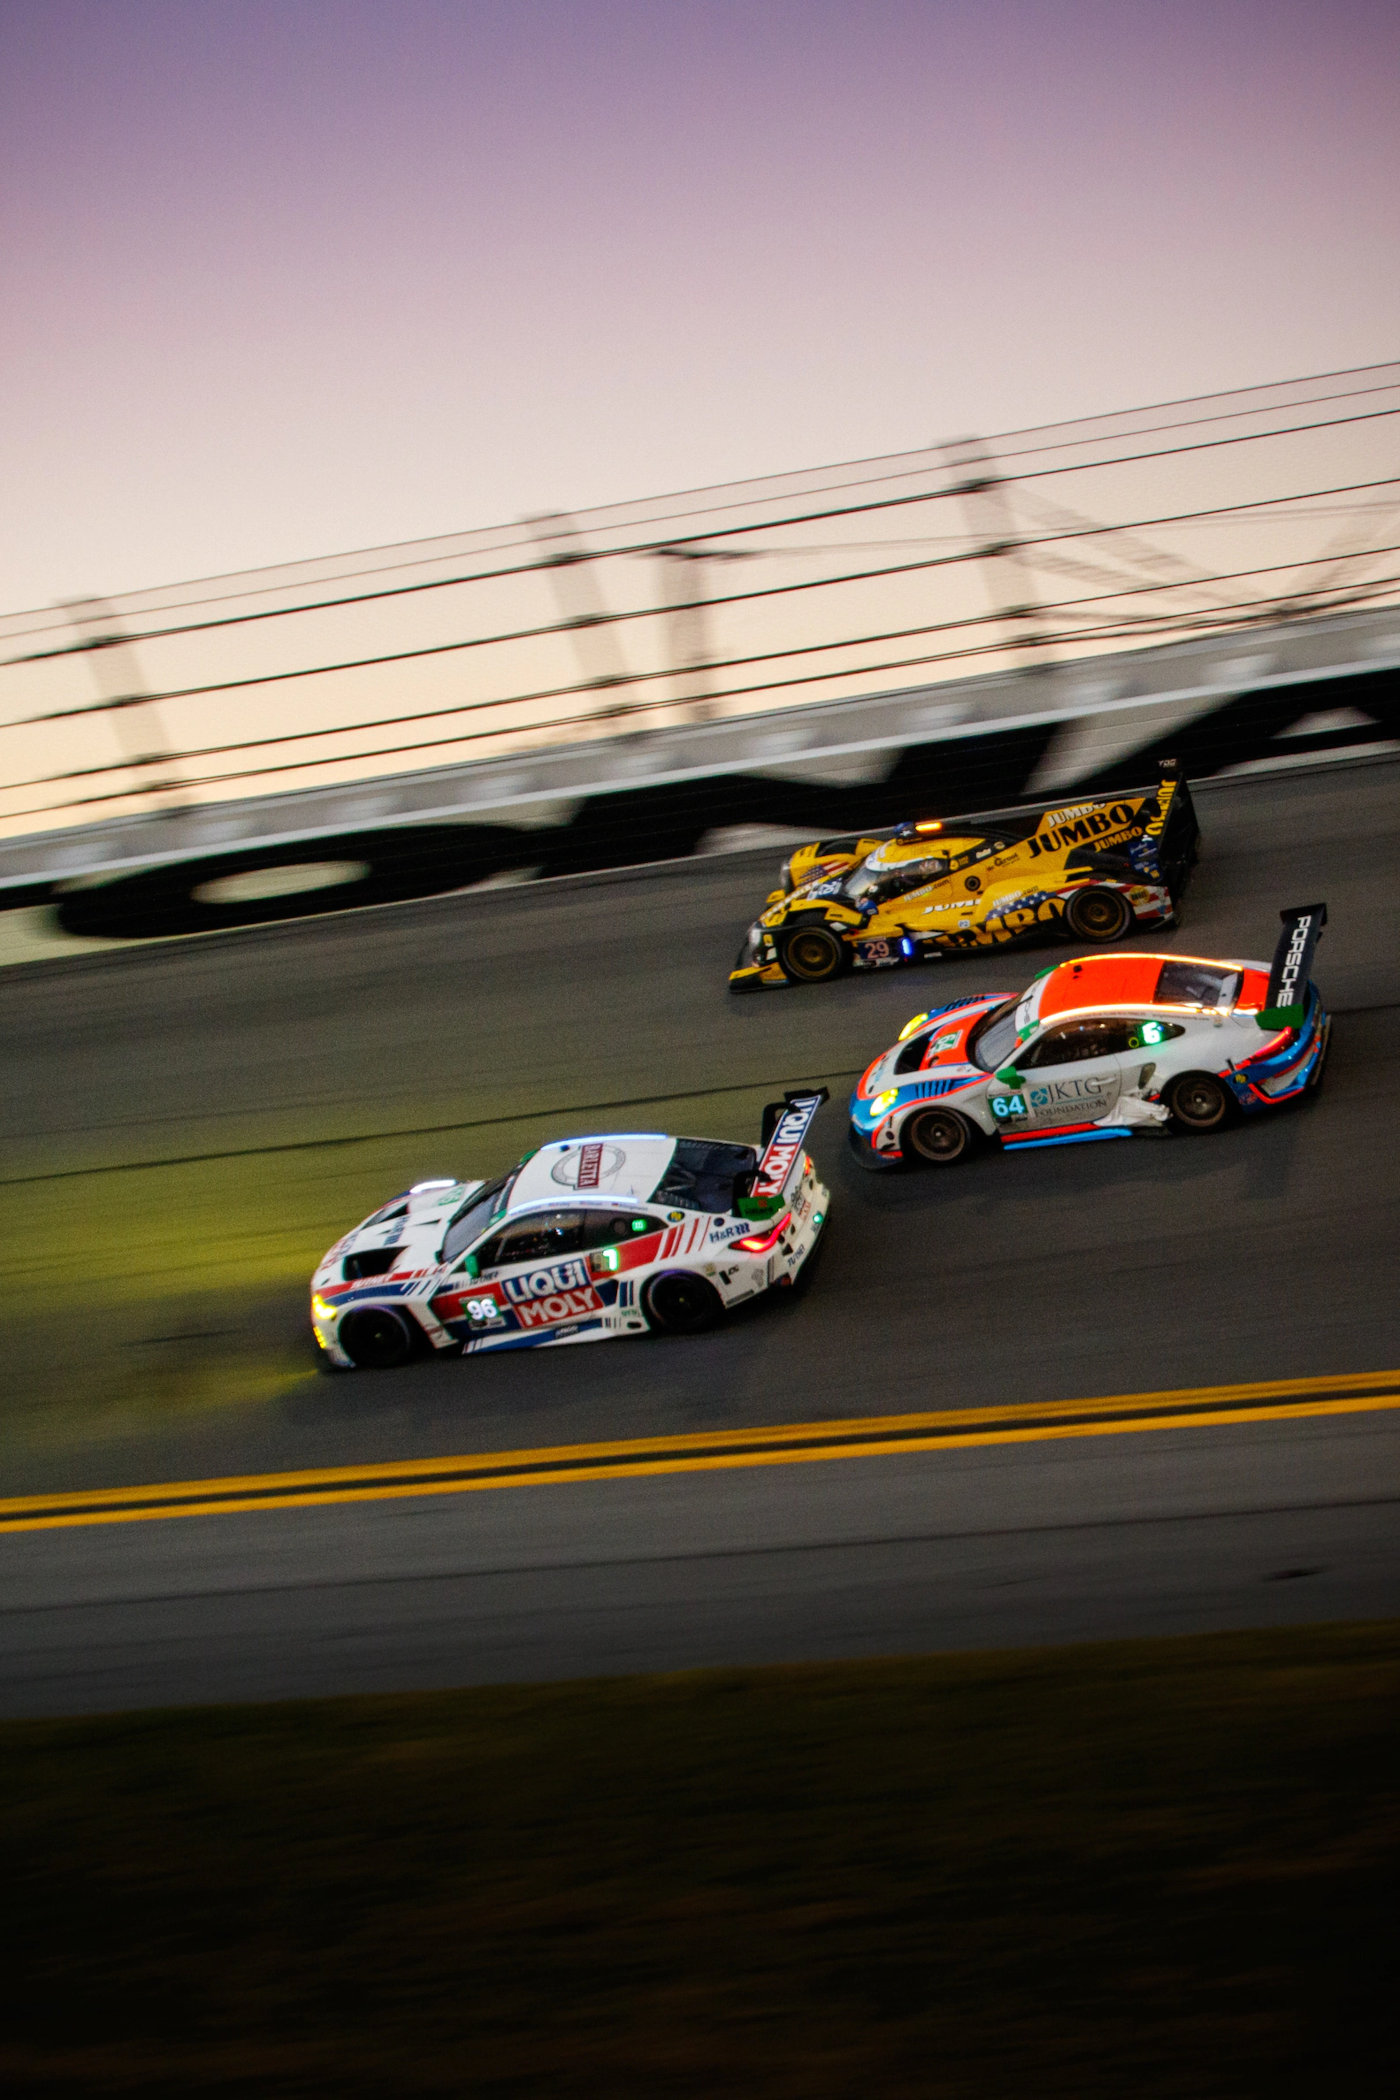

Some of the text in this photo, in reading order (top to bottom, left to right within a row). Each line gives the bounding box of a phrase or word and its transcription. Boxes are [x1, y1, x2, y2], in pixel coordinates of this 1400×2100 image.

[1029, 803, 1135, 859] JUMBO
[1094, 826, 1144, 853] JUMBO
[864, 942, 890, 959] 29
[1276, 915, 1312, 1008] PORSCHE
[1048, 1077, 1101, 1105] JKTG
[992, 1094, 1024, 1117] 64
[1034, 1098, 1107, 1118] FOUNDATION
[504, 1261, 587, 1302] LIQUI
[466, 1299, 498, 1320] 96
[517, 1288, 594, 1325] MOLY
